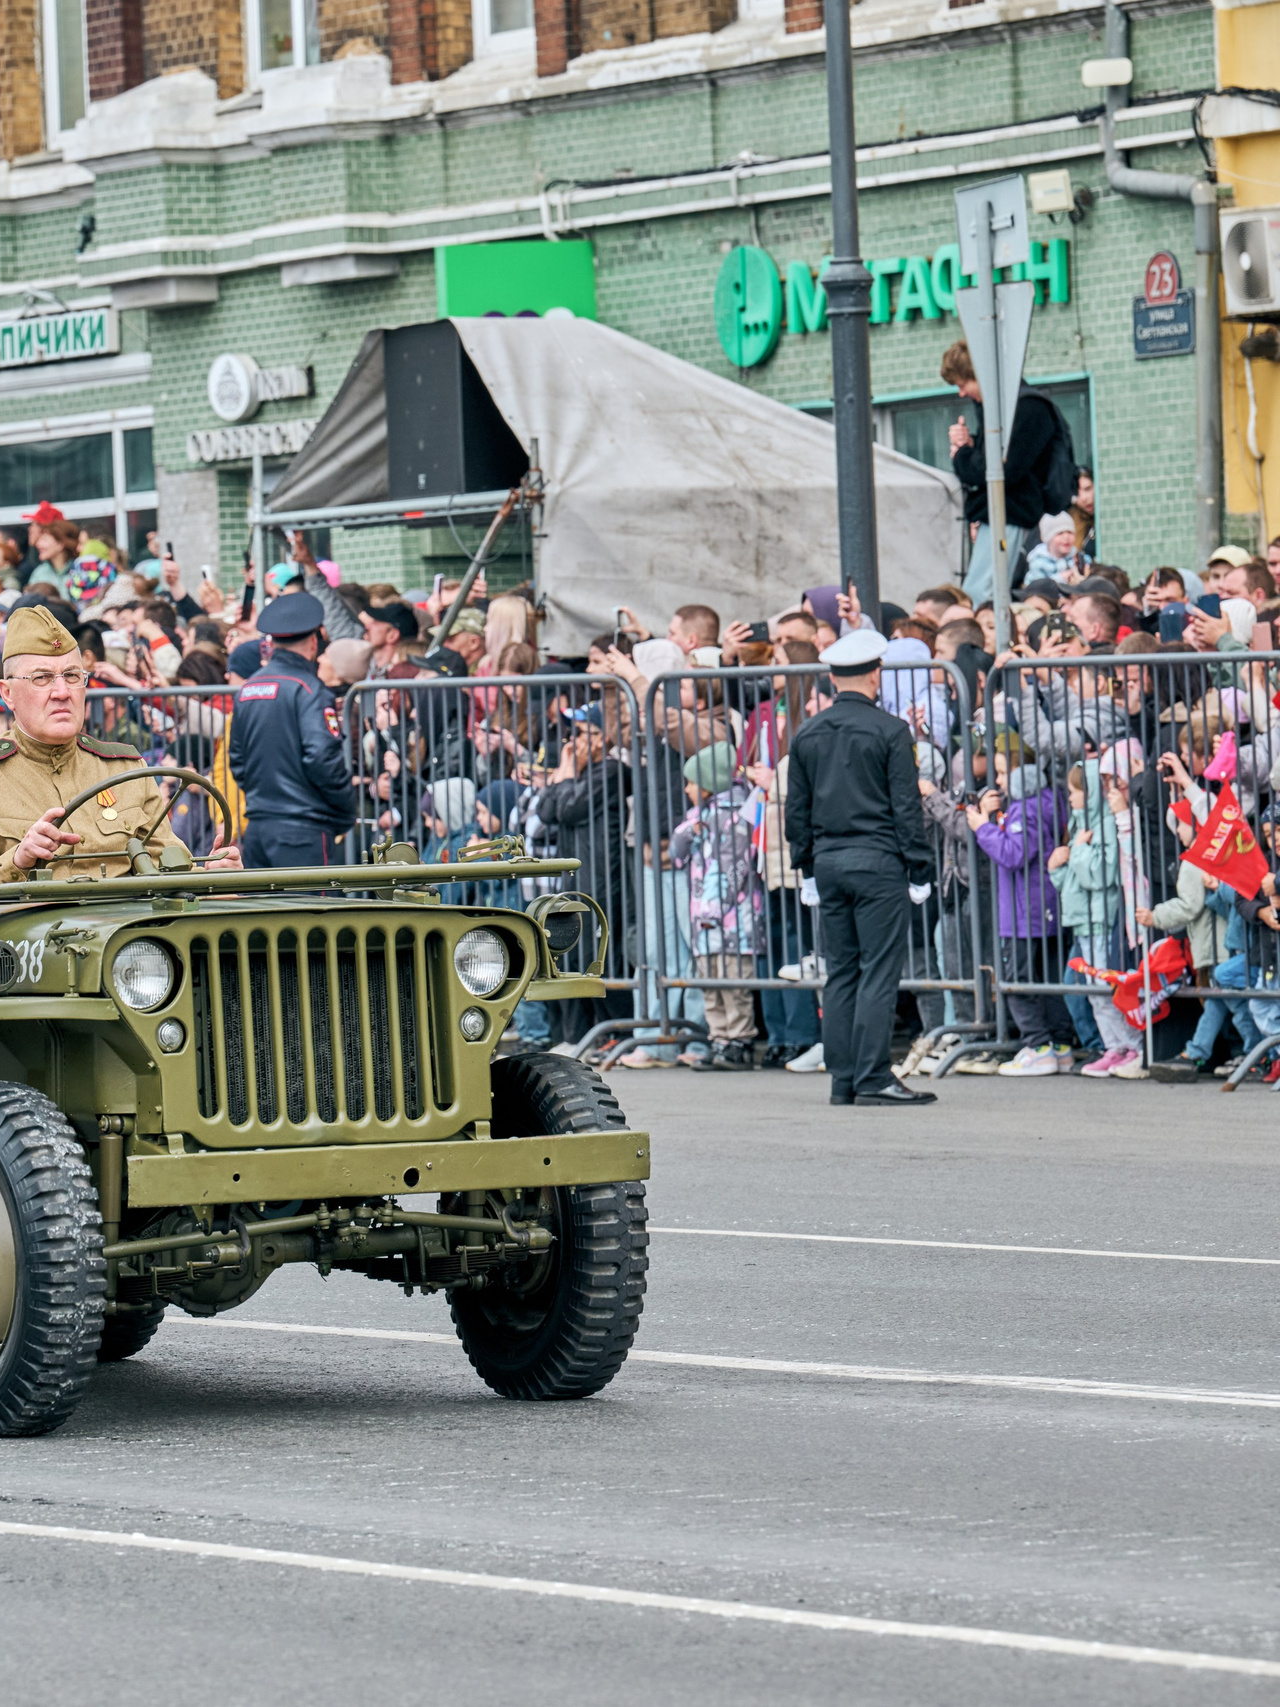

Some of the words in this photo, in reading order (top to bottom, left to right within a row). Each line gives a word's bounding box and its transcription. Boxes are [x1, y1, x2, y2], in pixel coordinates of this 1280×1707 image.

[786, 238, 1070, 334] МГАФН
[1149, 262, 1174, 298] 23
[1148, 308, 1175, 325] улица
